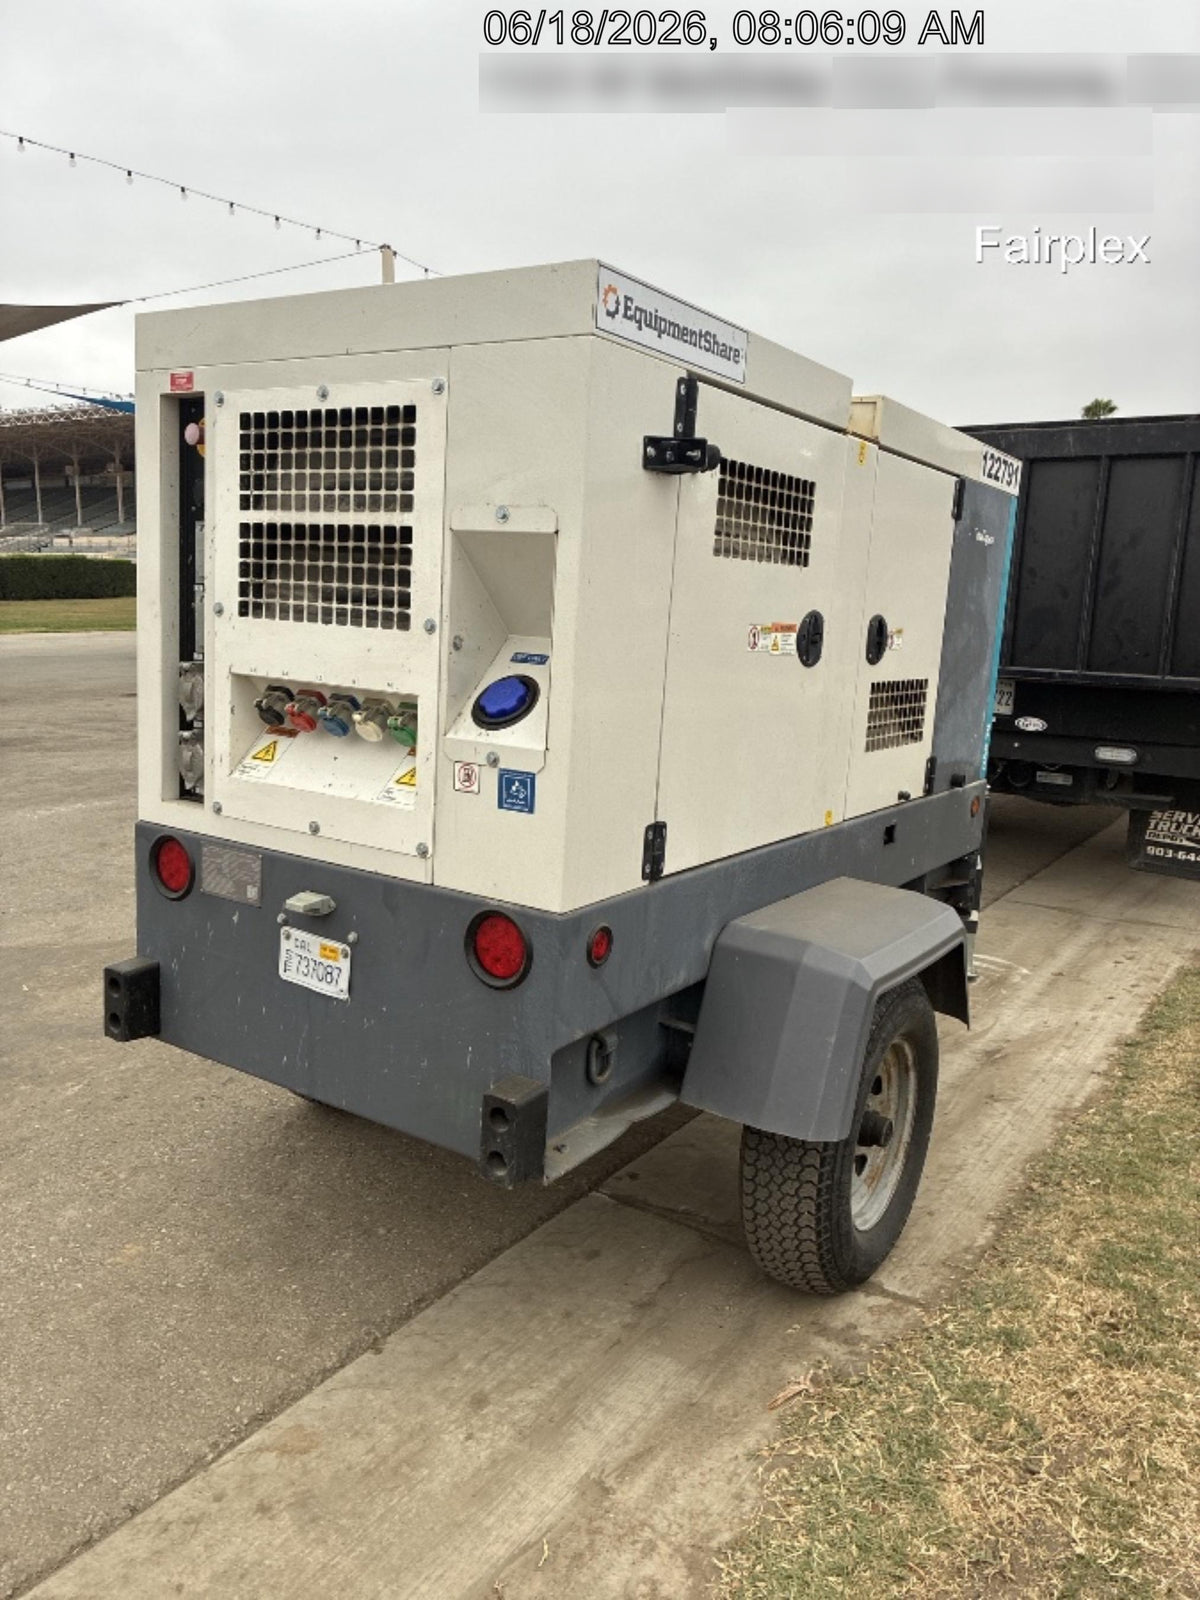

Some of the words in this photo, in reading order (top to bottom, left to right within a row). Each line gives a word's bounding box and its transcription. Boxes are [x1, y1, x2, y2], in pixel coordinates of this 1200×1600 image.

[622, 294, 741, 365] EquipmentShare
[982, 450, 1020, 489] 122791
[295, 953, 342, 986] 737087
